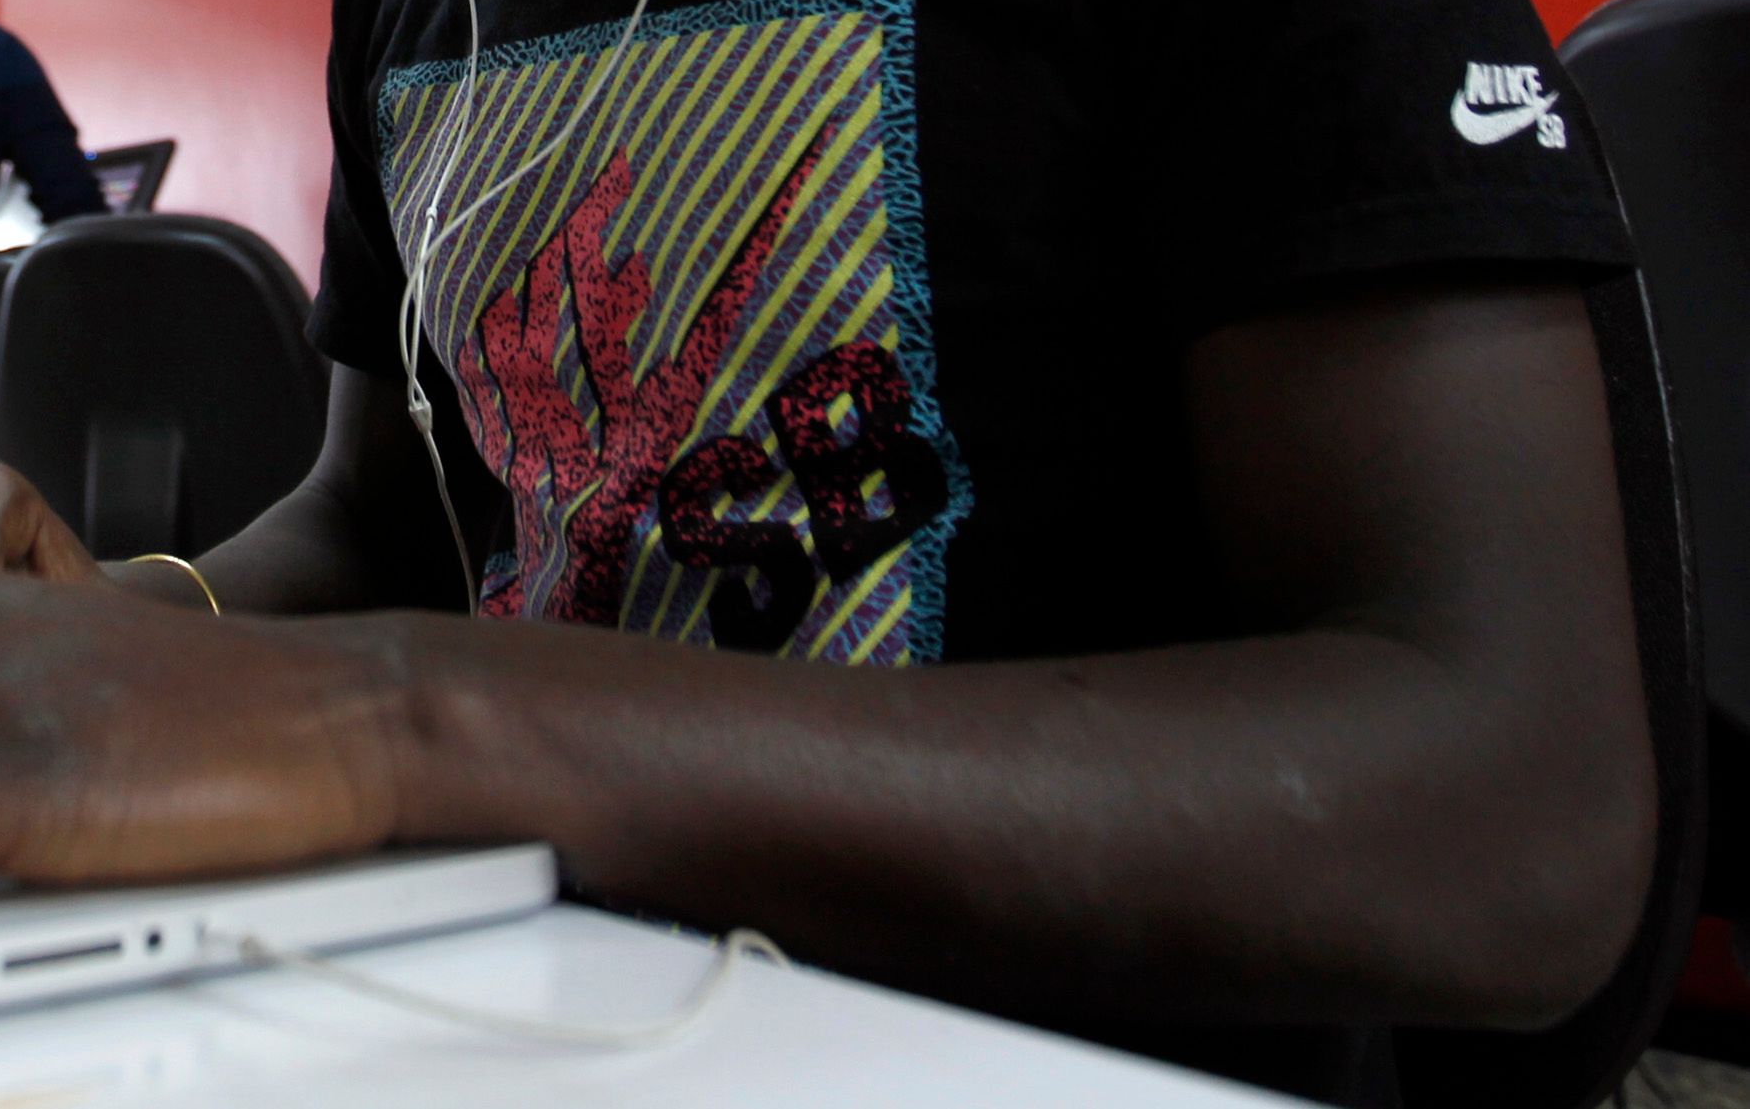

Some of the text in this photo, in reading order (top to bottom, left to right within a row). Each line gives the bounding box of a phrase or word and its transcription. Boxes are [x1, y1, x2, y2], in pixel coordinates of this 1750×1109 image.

[1464, 61, 1544, 106] NIKE
[1536, 113, 1567, 149] SB
[658, 338, 952, 650] SB
